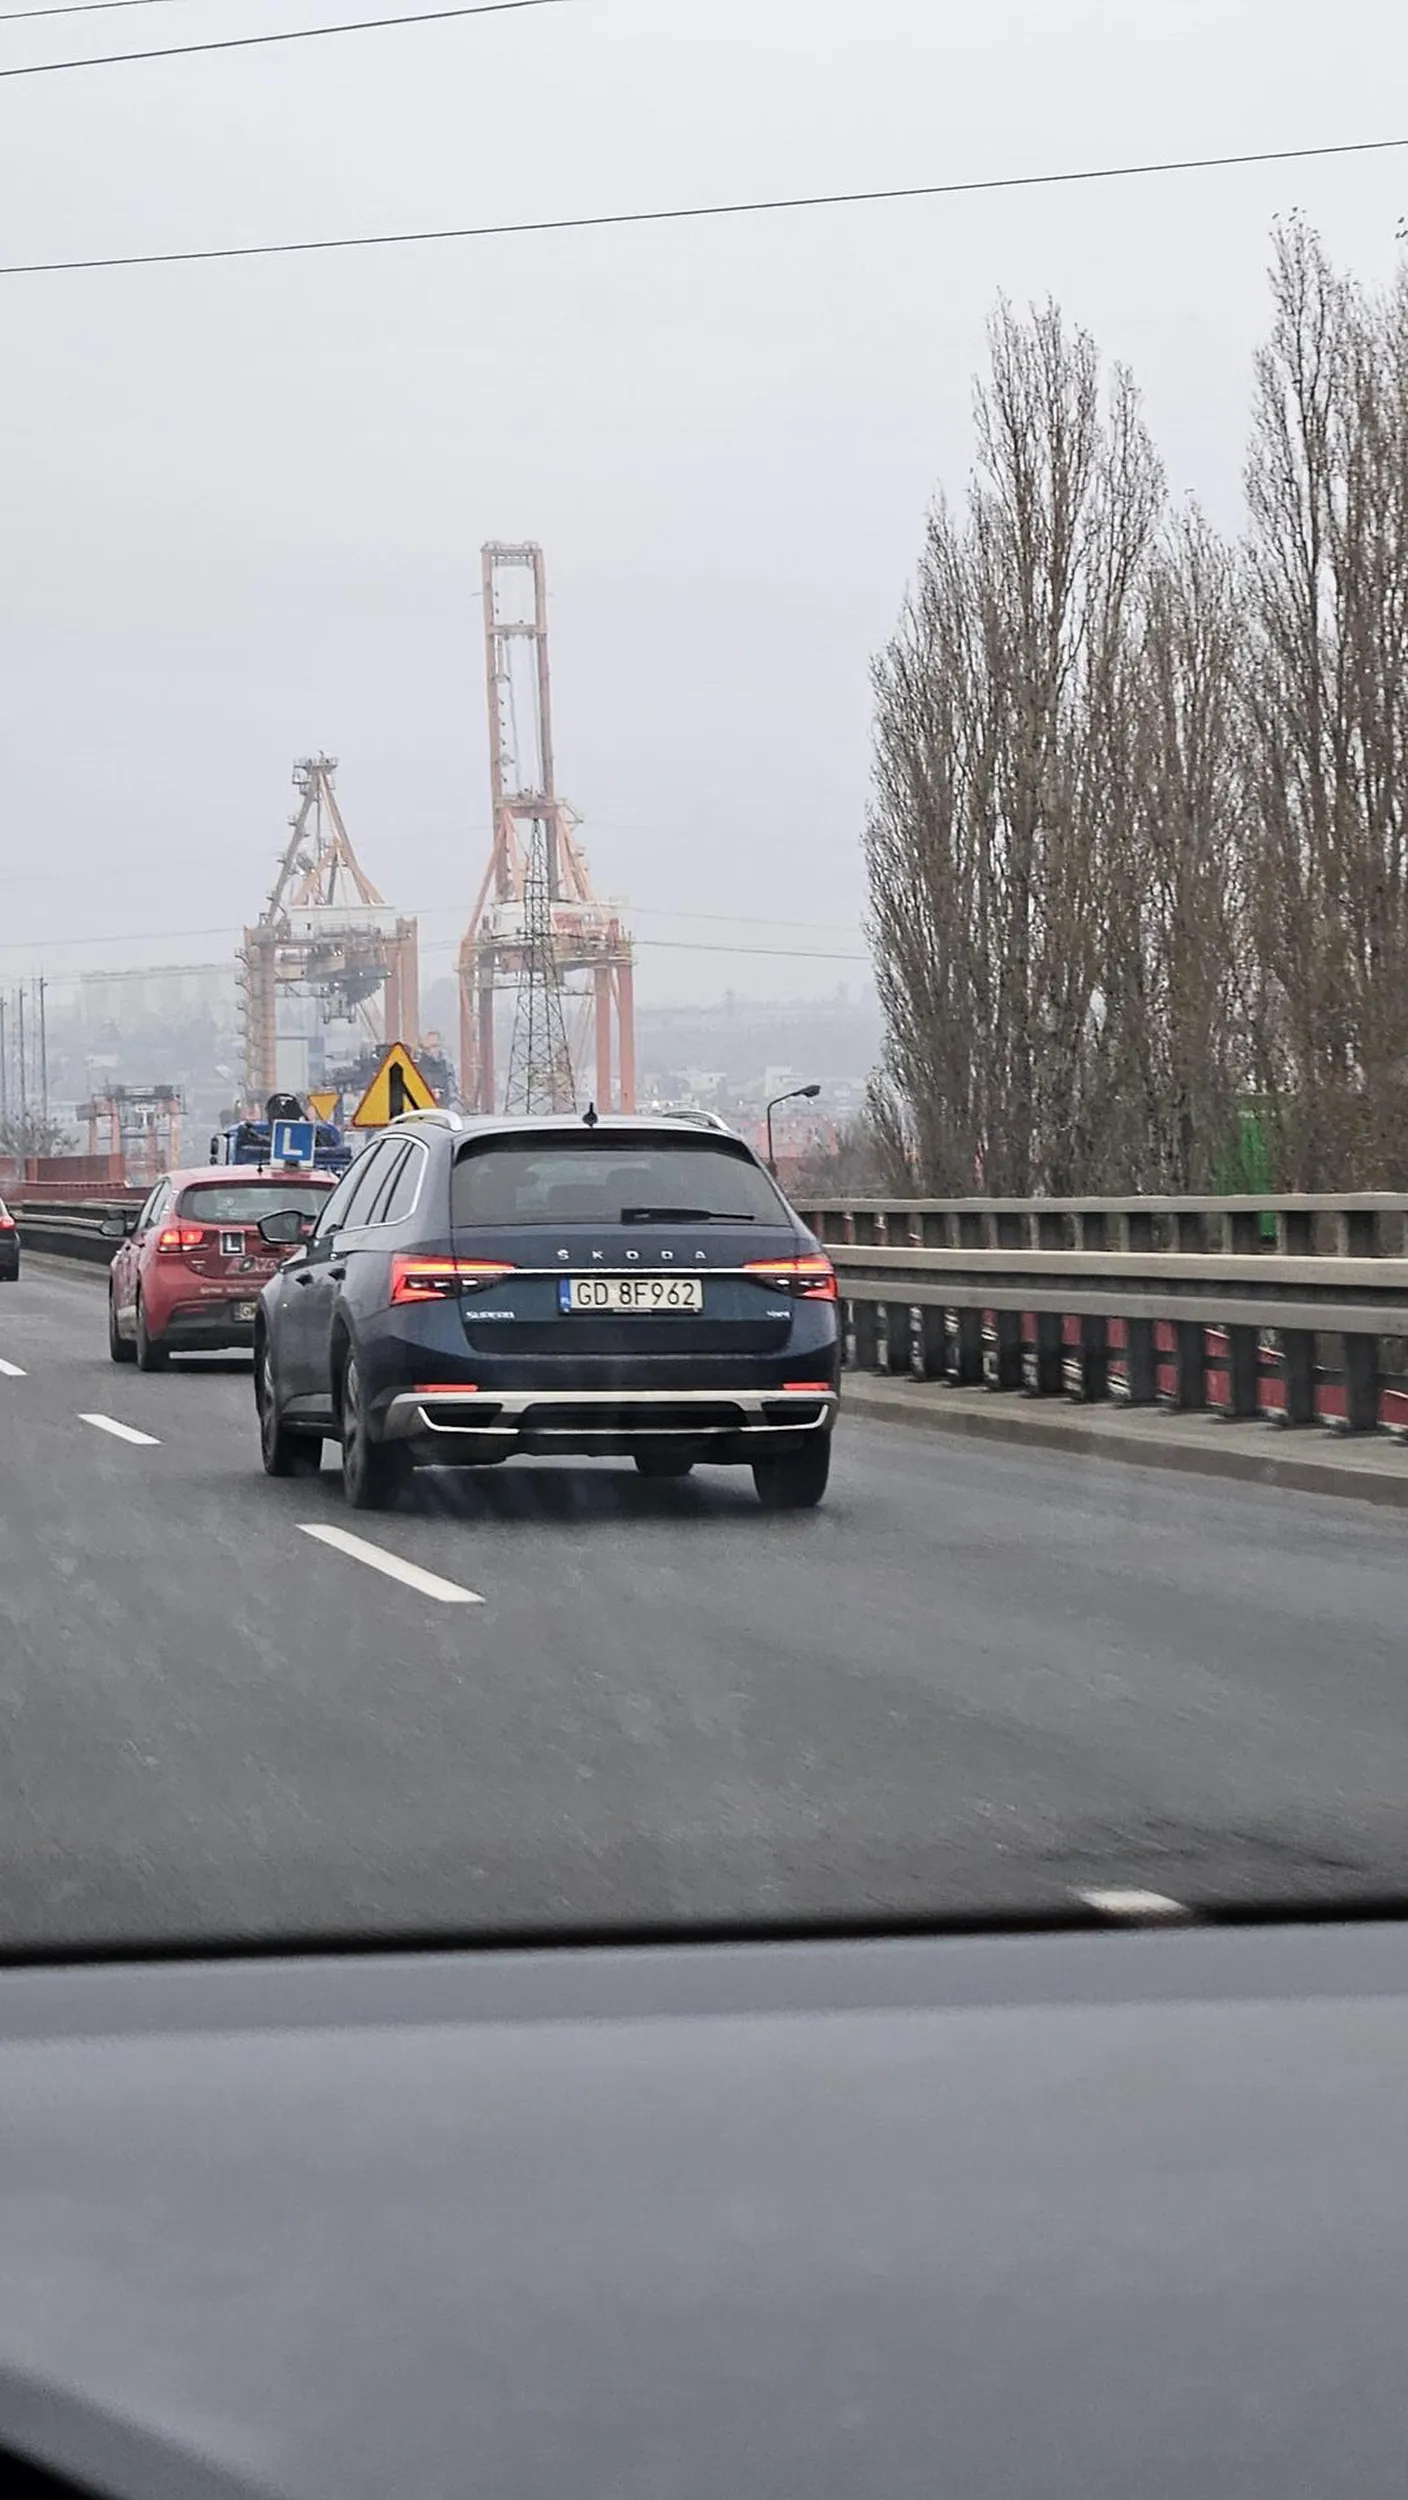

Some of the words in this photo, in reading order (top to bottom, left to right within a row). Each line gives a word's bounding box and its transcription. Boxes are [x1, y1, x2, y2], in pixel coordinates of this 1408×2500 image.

[282, 1127, 303, 1155] L
[226, 1234, 241, 1251] L
[557, 1249, 706, 1260] SKODA
[577, 1282, 608, 1305] GD
[619, 1282, 695, 1305] 8F962
